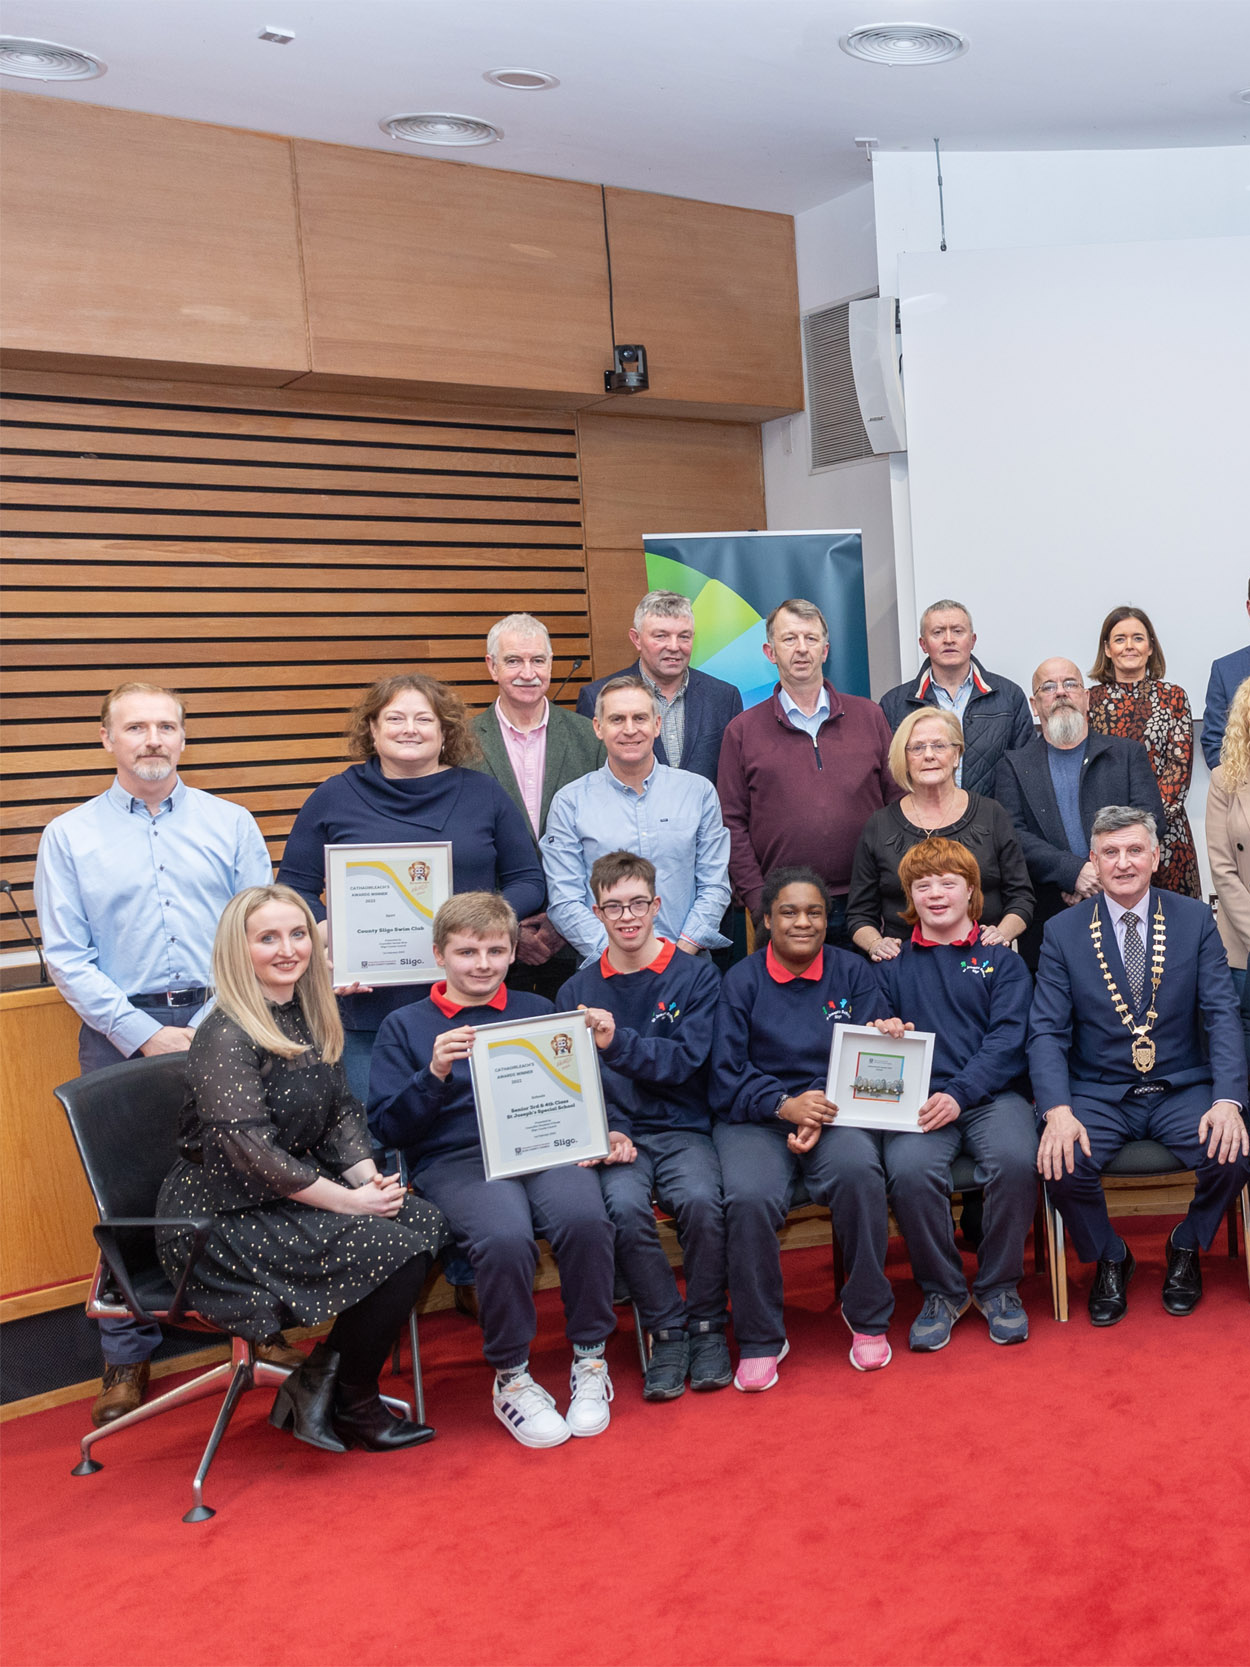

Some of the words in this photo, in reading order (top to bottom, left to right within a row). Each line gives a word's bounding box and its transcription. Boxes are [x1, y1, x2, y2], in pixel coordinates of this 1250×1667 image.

[514, 1110, 536, 1119] Joseph's
[538, 1106, 557, 1115] Special
[558, 1103, 575, 1111] School
[554, 1137, 578, 1147] Sligo.
